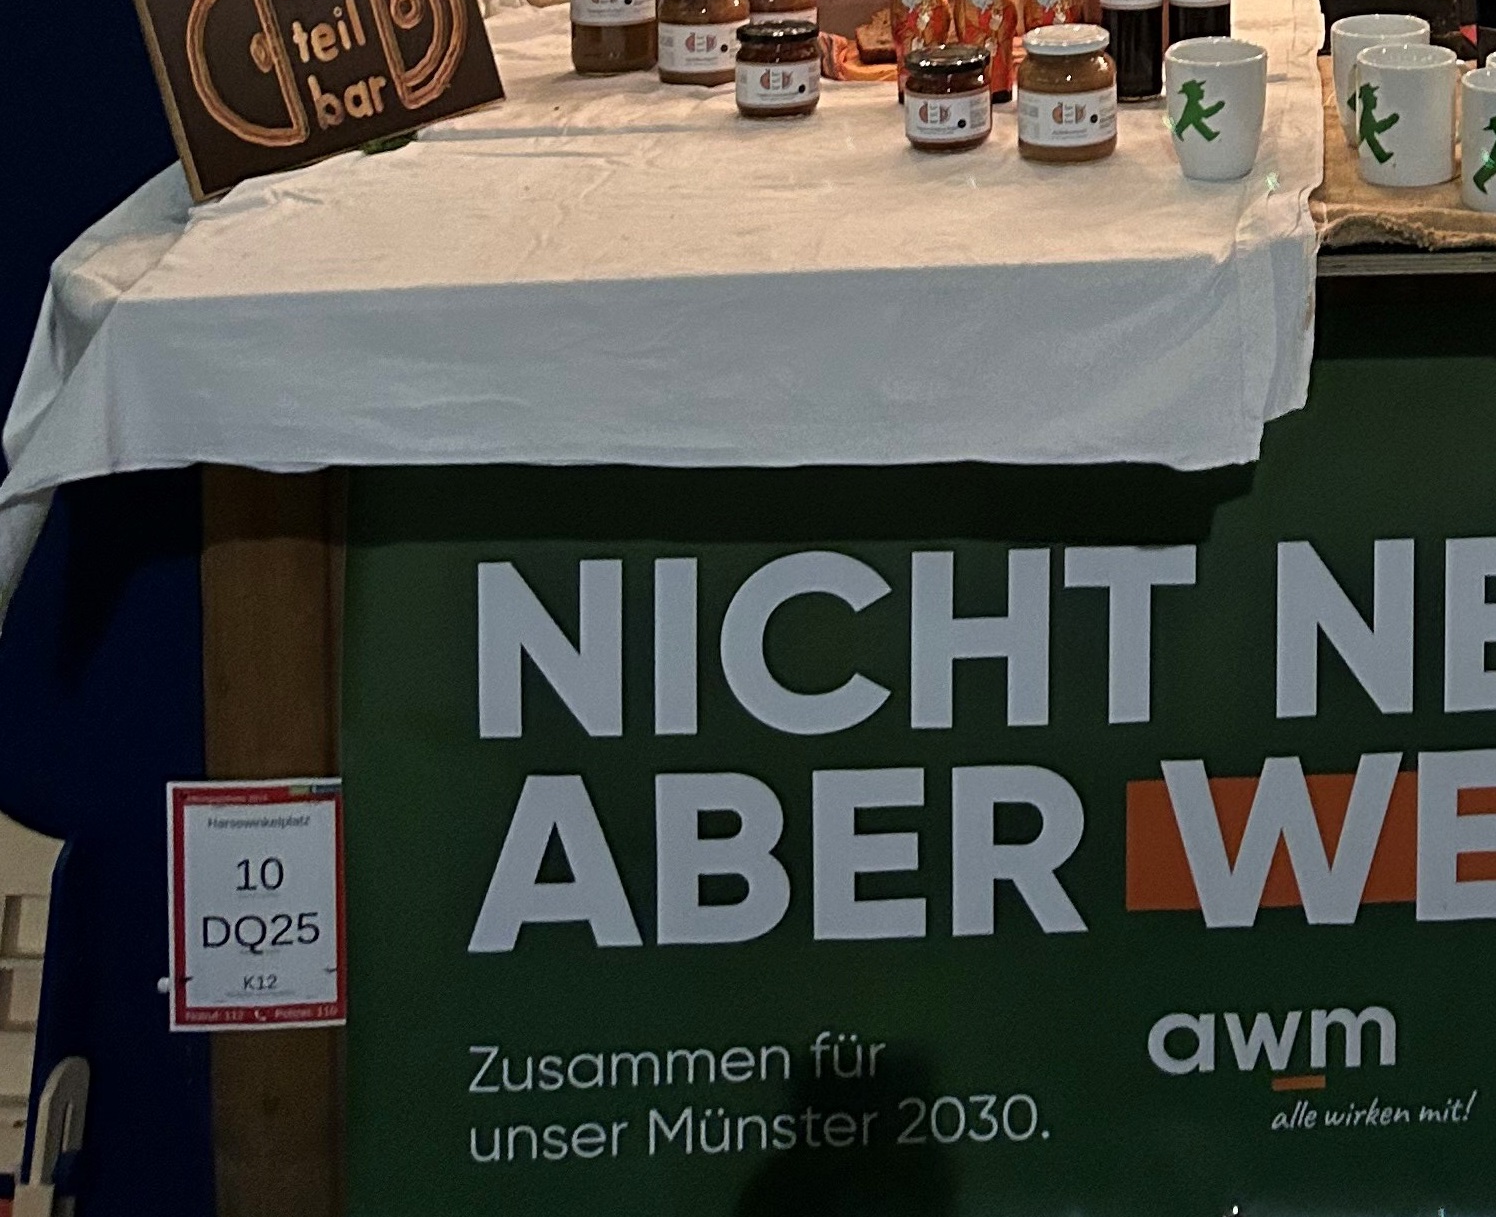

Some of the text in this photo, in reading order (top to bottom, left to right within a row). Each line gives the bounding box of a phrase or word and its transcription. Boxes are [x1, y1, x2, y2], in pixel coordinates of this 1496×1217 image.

[308, 74, 387, 130] bar
[478, 546, 1198, 739] NICHT
[236, 857, 285, 891] 10
[467, 765, 1088, 952] ABER
[202, 912, 321, 955] DQ25
[243, 973, 278, 990] K12
[468, 1031, 887, 1093] Zusammen für
[1147, 1006, 1397, 1075] awm
[470, 1094, 1050, 1162] unser Münster 2030.
[1271, 1089, 1478, 1130] alle wirken mit!
